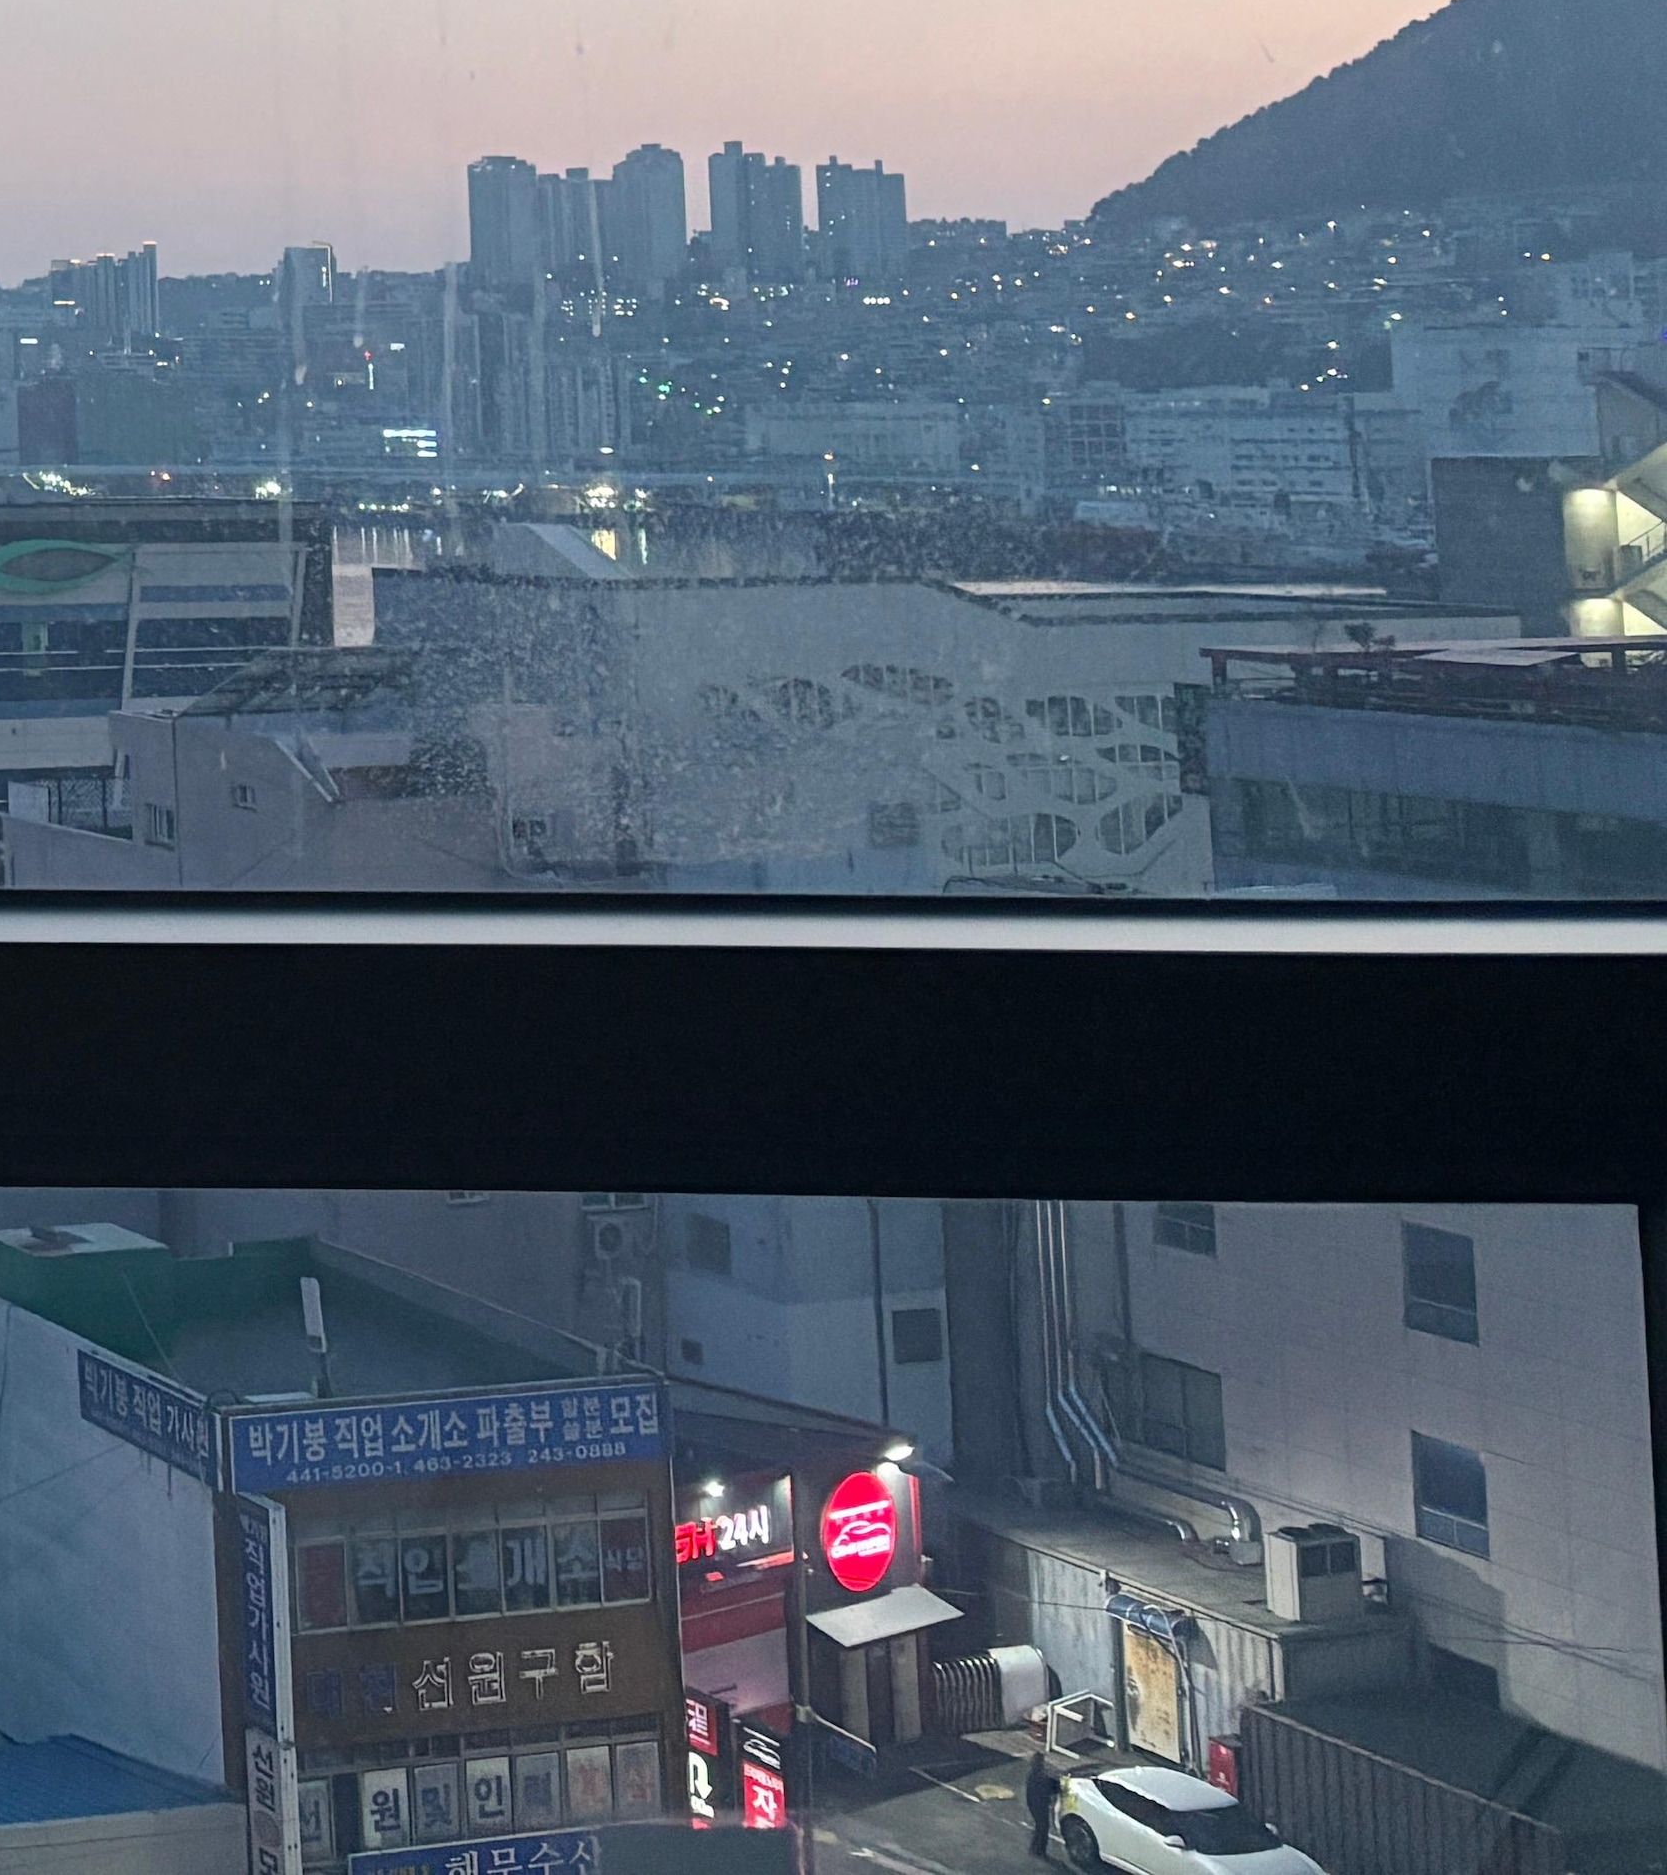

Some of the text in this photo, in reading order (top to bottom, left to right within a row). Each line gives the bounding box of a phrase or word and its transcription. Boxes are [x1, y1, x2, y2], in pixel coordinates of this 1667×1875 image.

[249, 1418, 328, 1466] 박기봉
[334, 1414, 385, 1459] 직업
[390, 1408, 468, 1453] 소개소
[475, 1399, 554, 1448] 파출부
[610, 1392, 659, 1436] 모집
[413, 1453, 513, 1474] 463-2323
[526, 1441, 627, 1465] 243-0888
[716, 1505, 770, 1551] 24시
[412, 1640, 614, 1712] 선원구함
